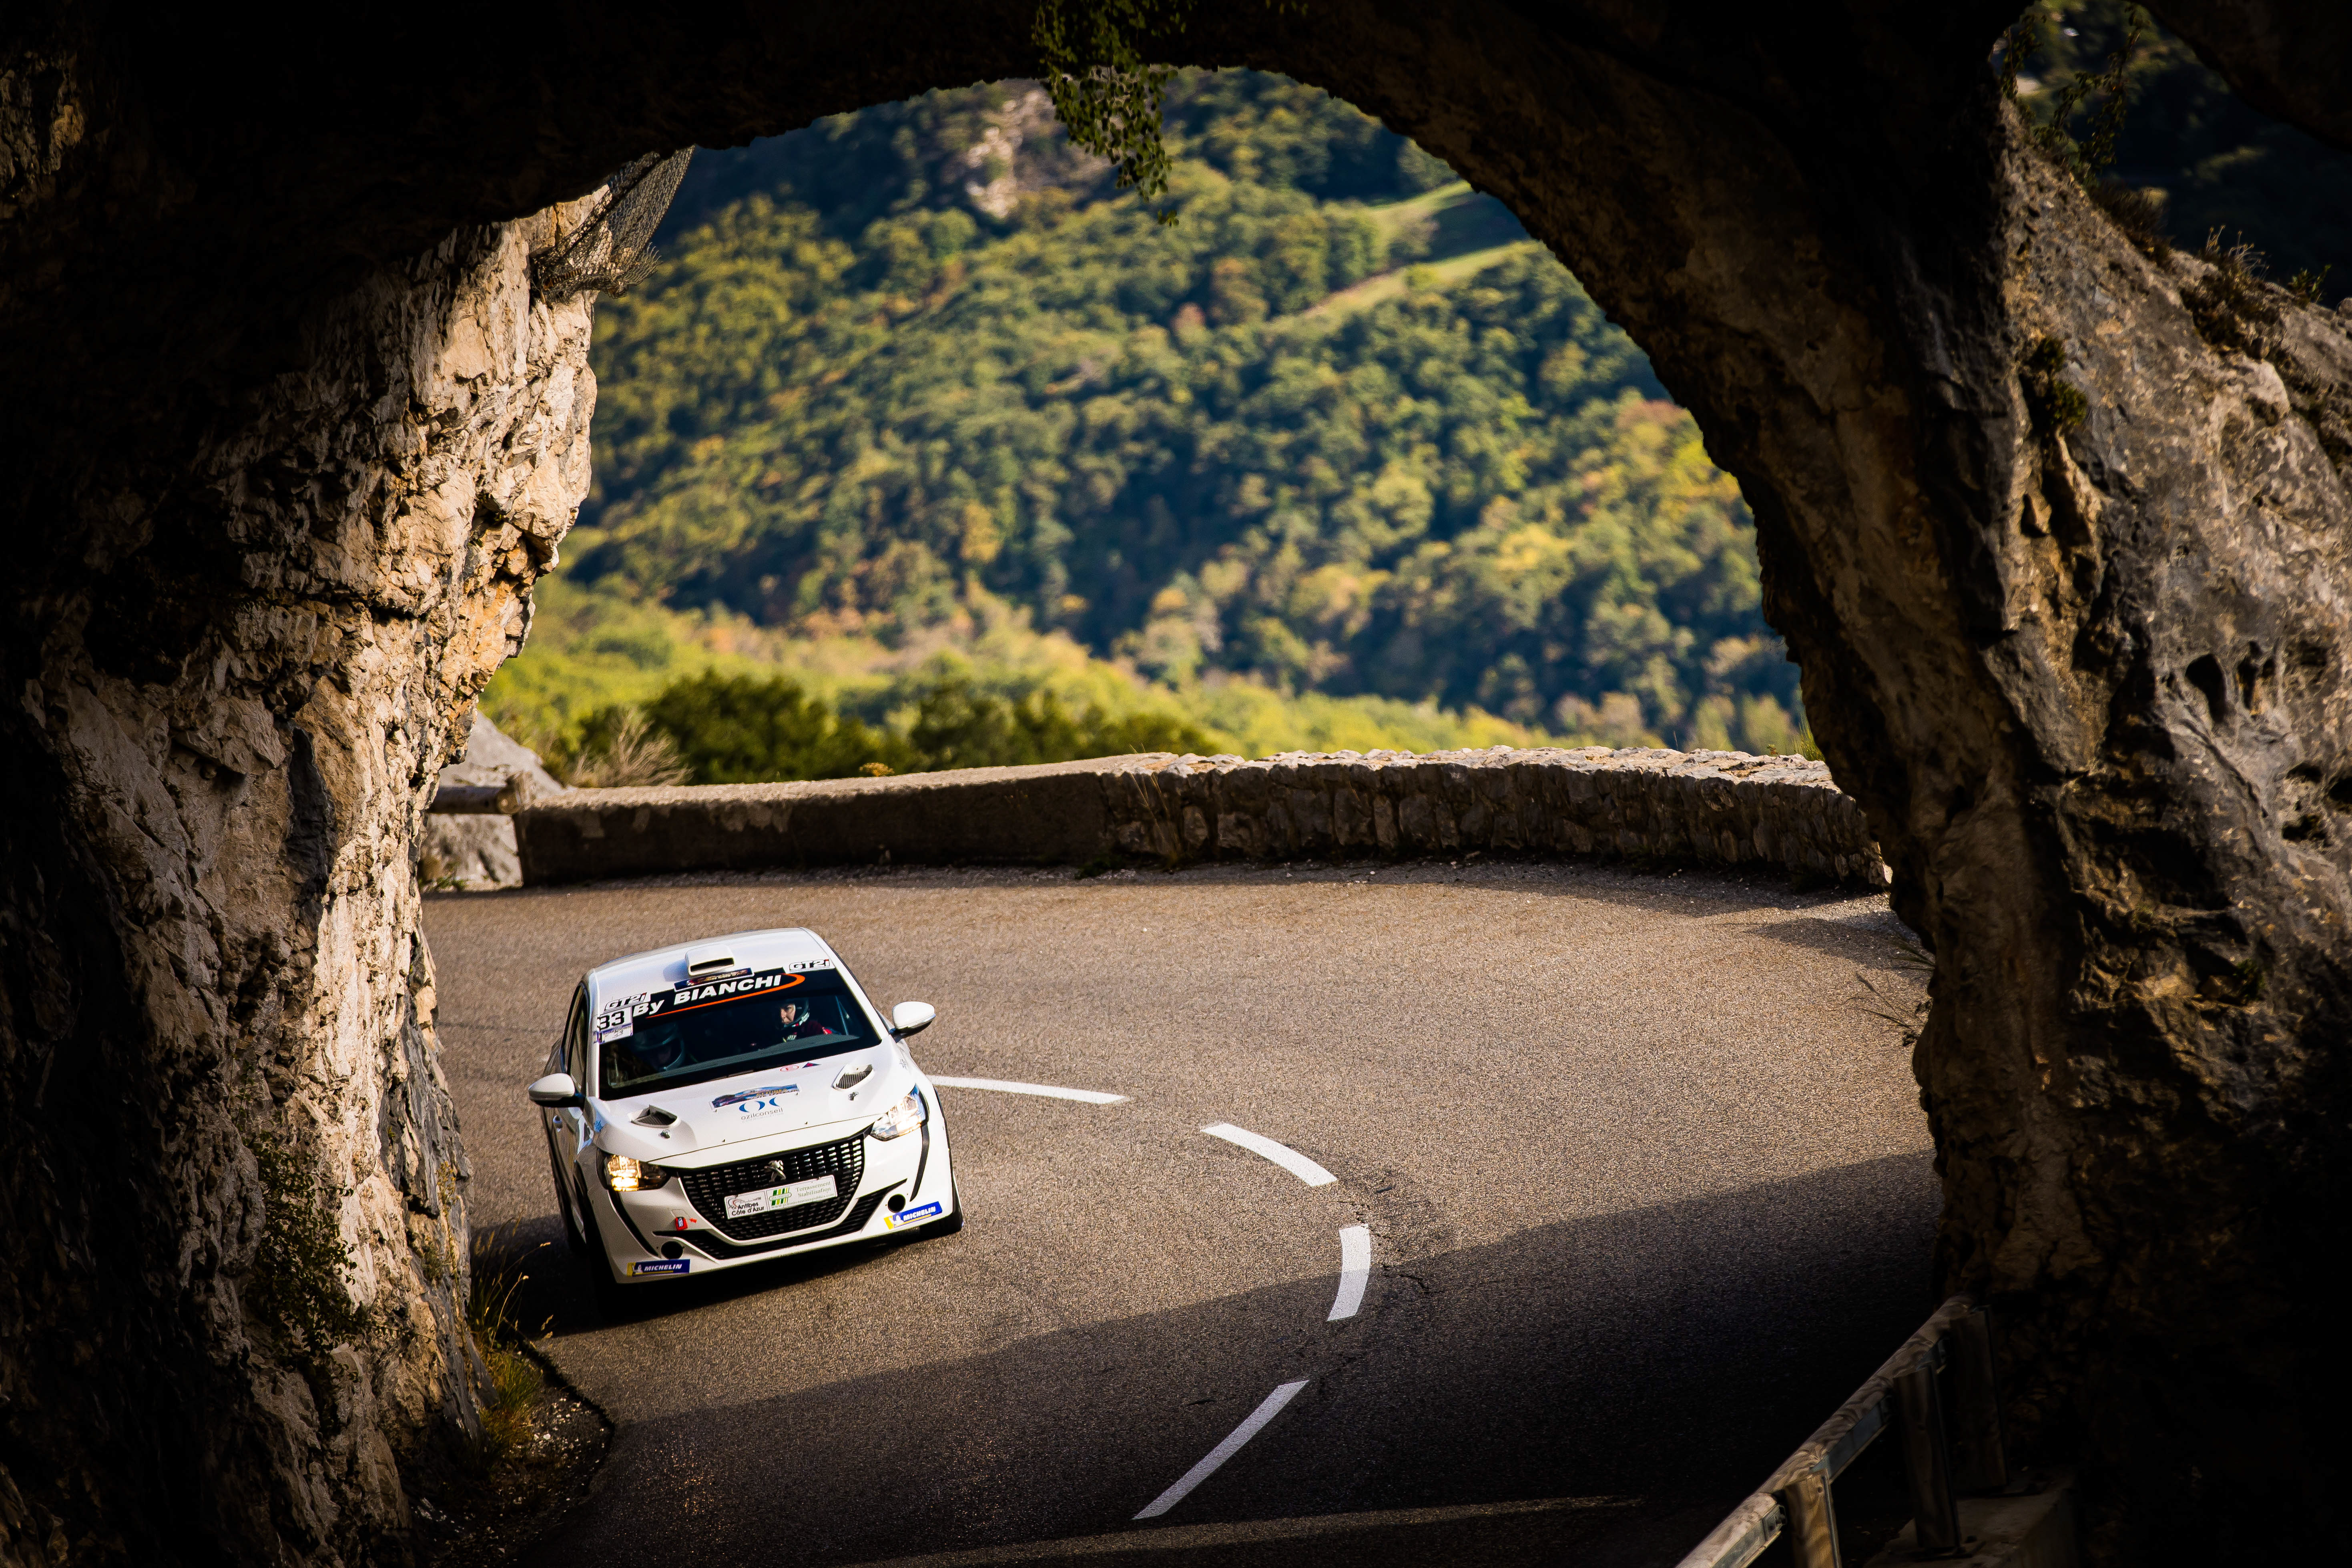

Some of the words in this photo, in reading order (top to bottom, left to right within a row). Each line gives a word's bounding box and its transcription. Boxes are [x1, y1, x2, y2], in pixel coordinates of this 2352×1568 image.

[633, 1000, 664, 1017] By
[674, 974, 782, 1005] BIANCHI
[795, 1181, 831, 1192] Terrassement
[798, 1187, 831, 1198] Stabilisation
[903, 1206, 936, 1221] MICHELIN
